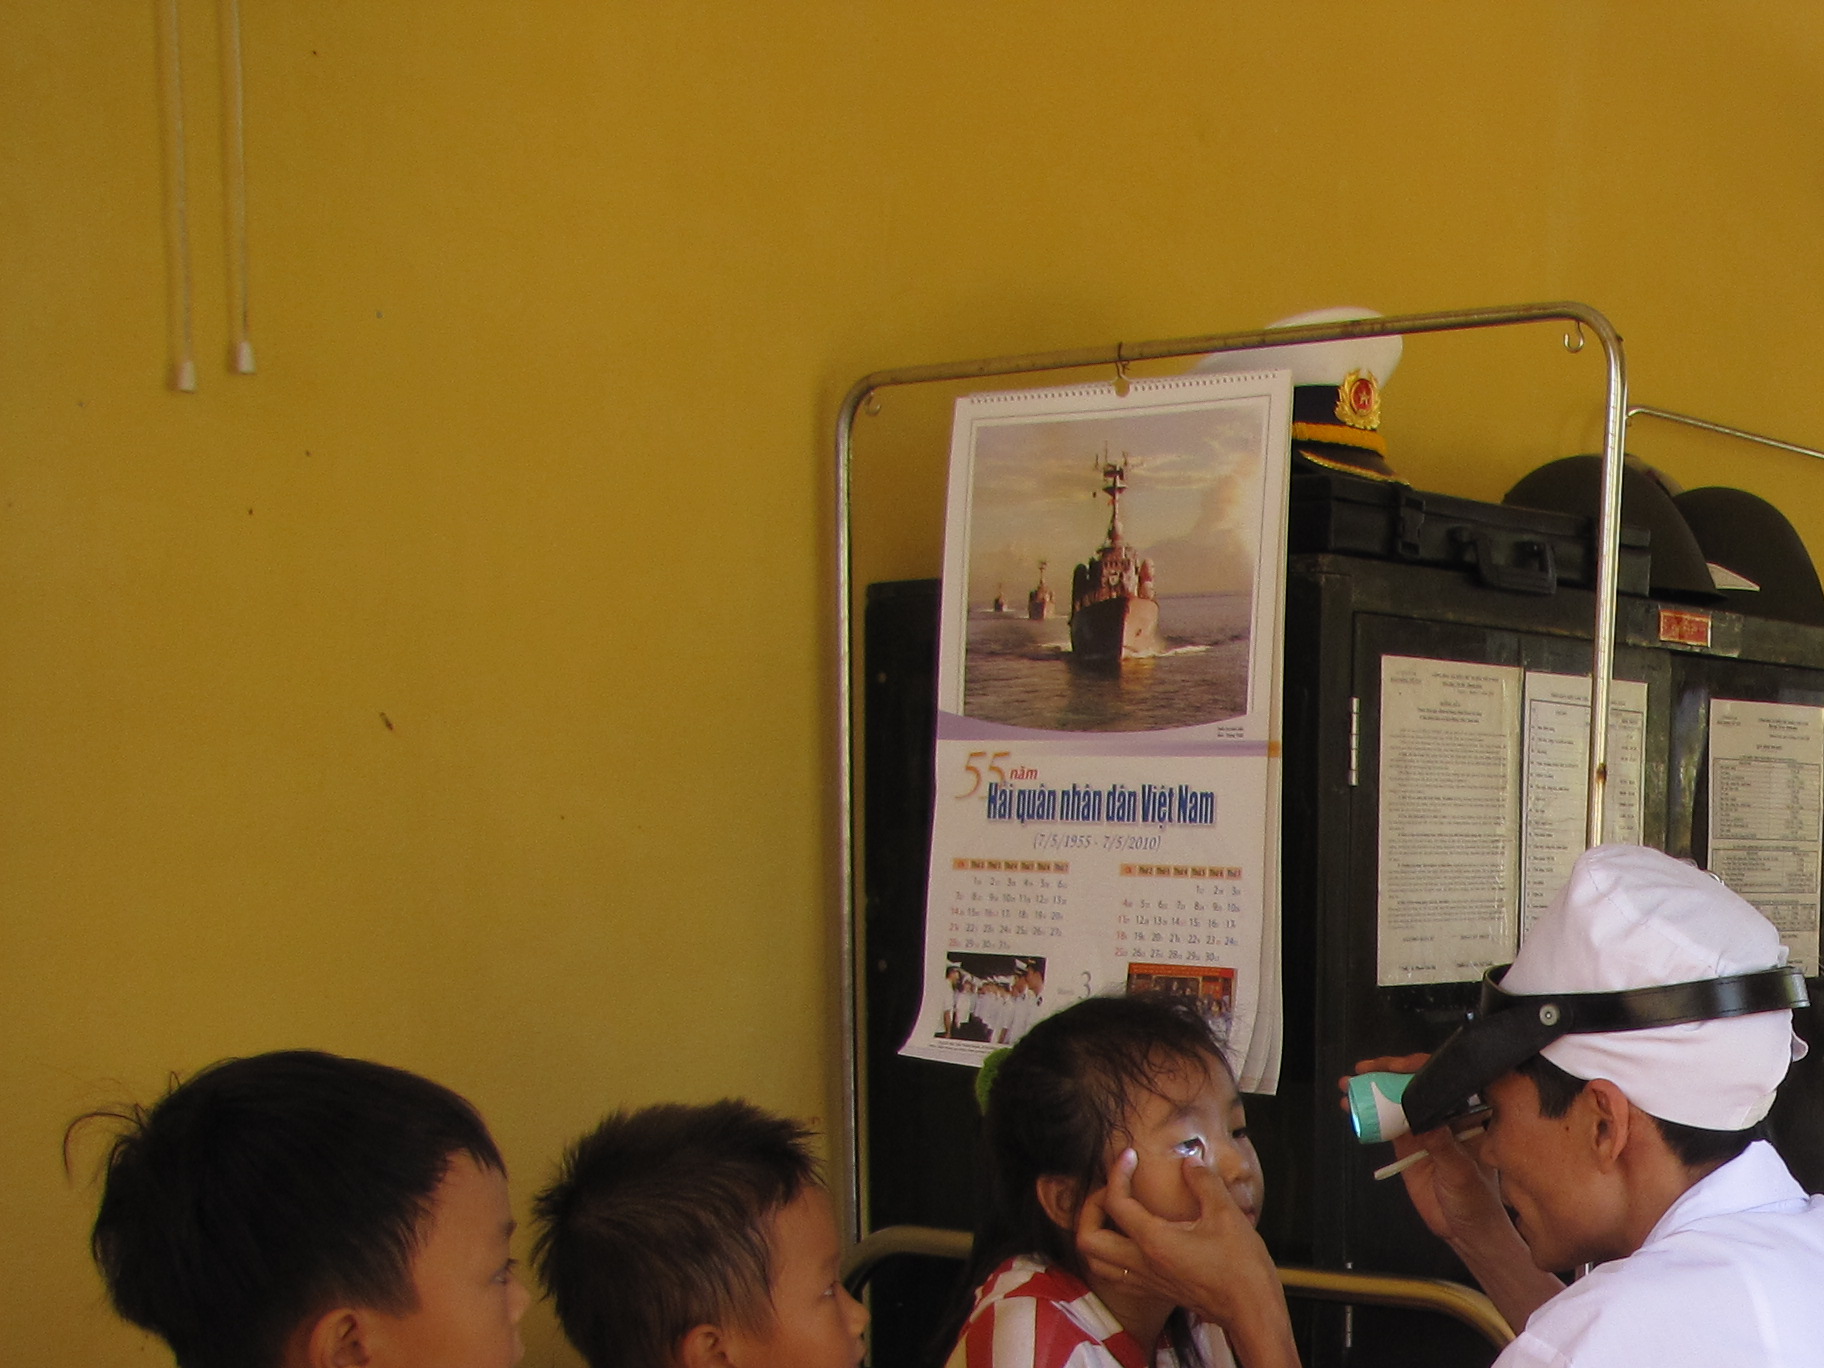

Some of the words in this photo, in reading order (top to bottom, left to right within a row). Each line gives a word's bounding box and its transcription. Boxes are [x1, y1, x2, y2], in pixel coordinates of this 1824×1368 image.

[955, 751, 1010, 800] 55
[1010, 765, 1038, 780] năm
[987, 781, 1013, 819] Hải
[1017, 783, 1056, 824] quân
[1060, 783, 1101, 821] nhân
[1106, 784, 1137, 822] dân
[1142, 784, 1174, 829] Việt
[1178, 784, 1215, 824] Nam
[1103, 835, 1162, 852] 7/5/2010)
[1079, 971, 1092, 999] 3
